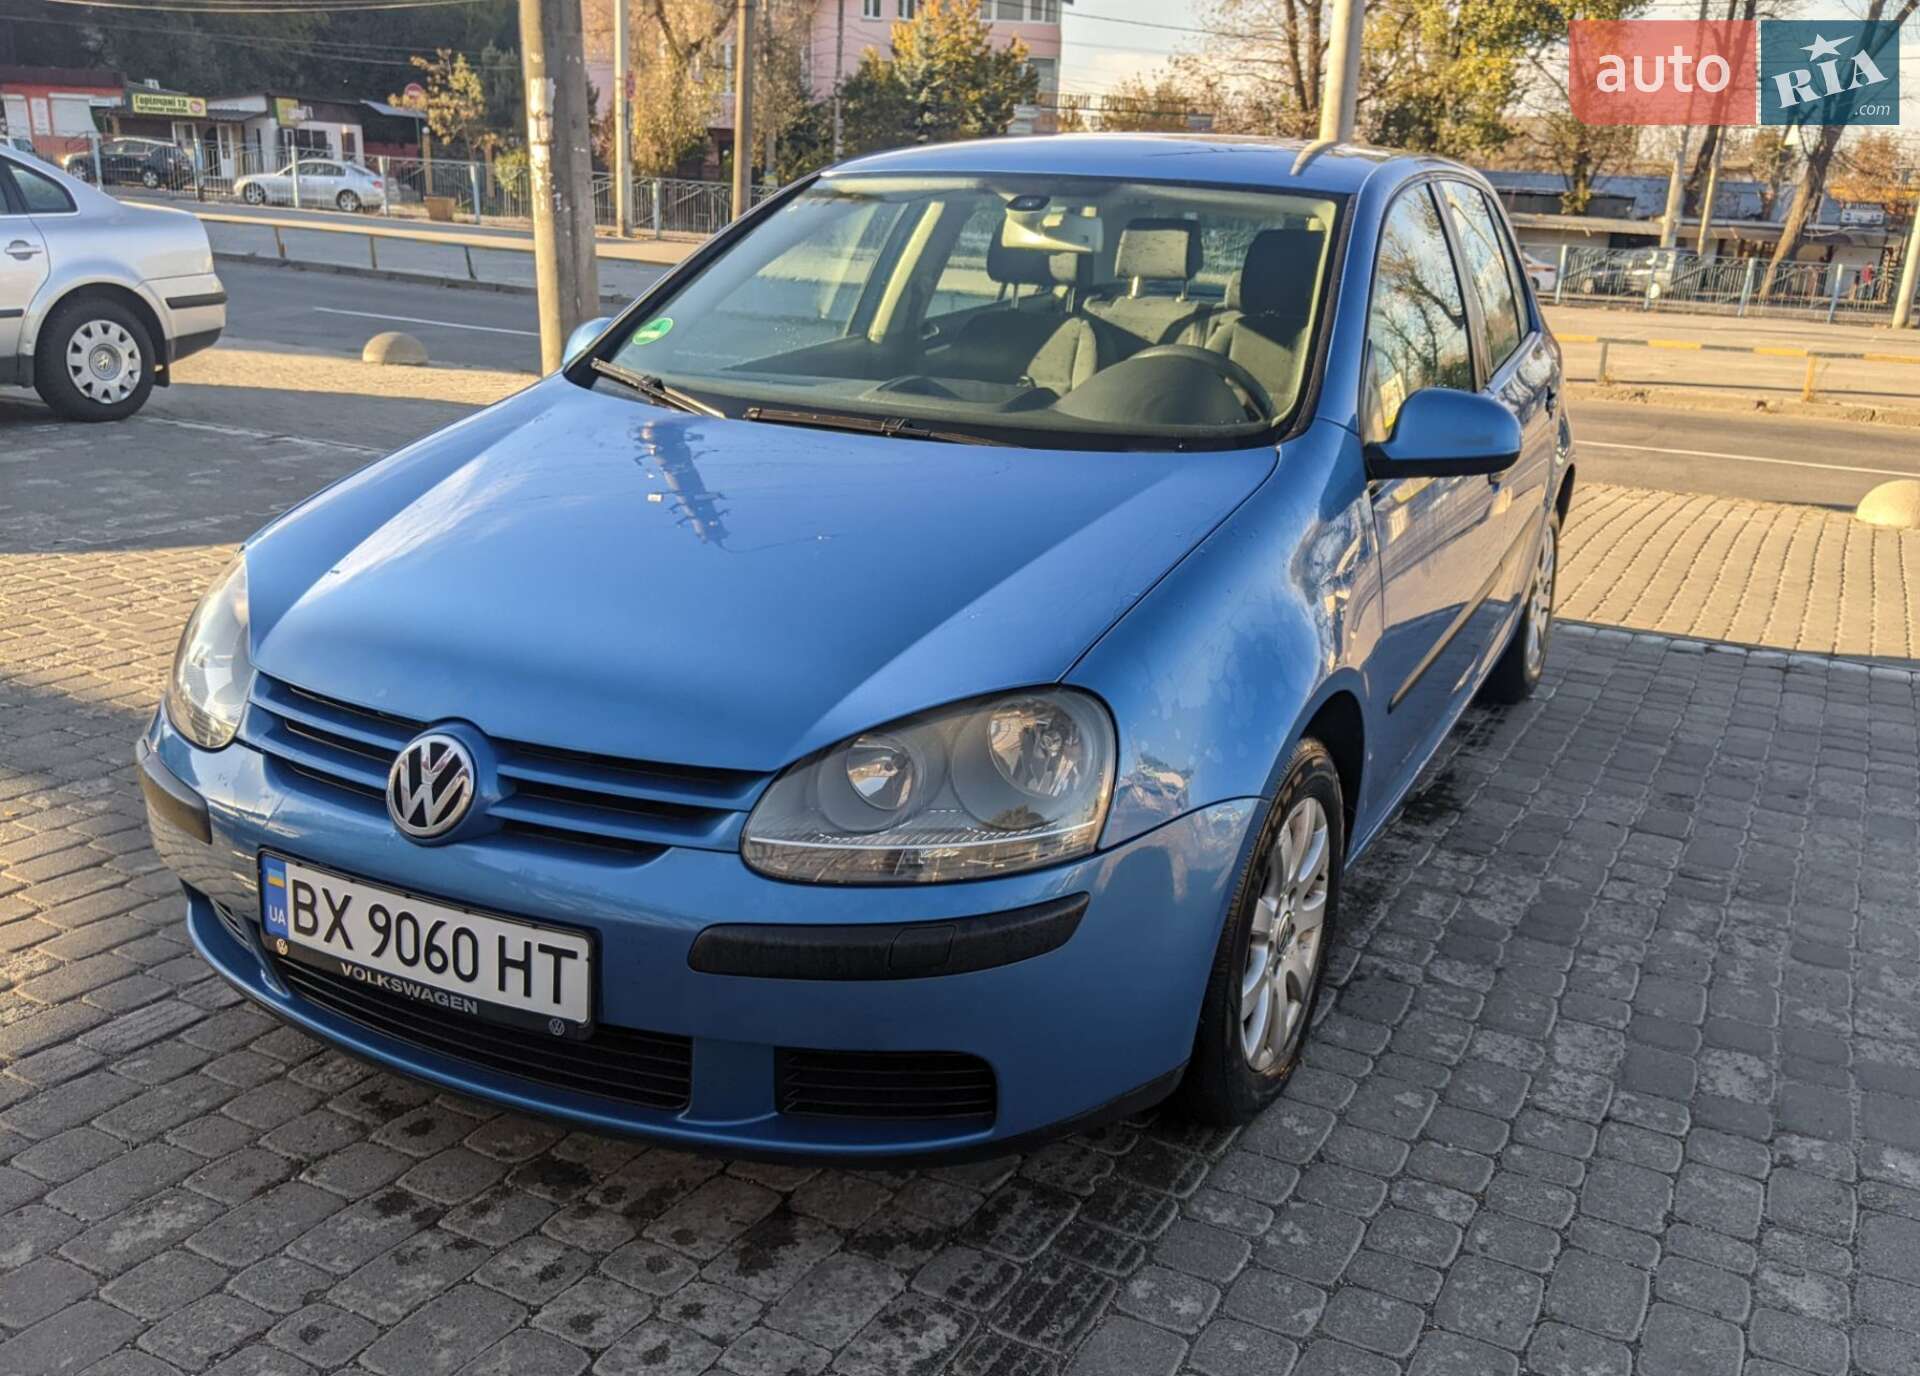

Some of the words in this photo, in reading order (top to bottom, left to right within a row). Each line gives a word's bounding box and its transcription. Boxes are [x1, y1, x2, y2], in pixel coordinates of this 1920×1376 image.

[268, 904, 287, 926] UA
[292, 879, 354, 951] BX
[368, 903, 479, 983] 9060
[498, 935, 578, 1005] HT
[340, 961, 479, 1015] VOLKSWAGEN
